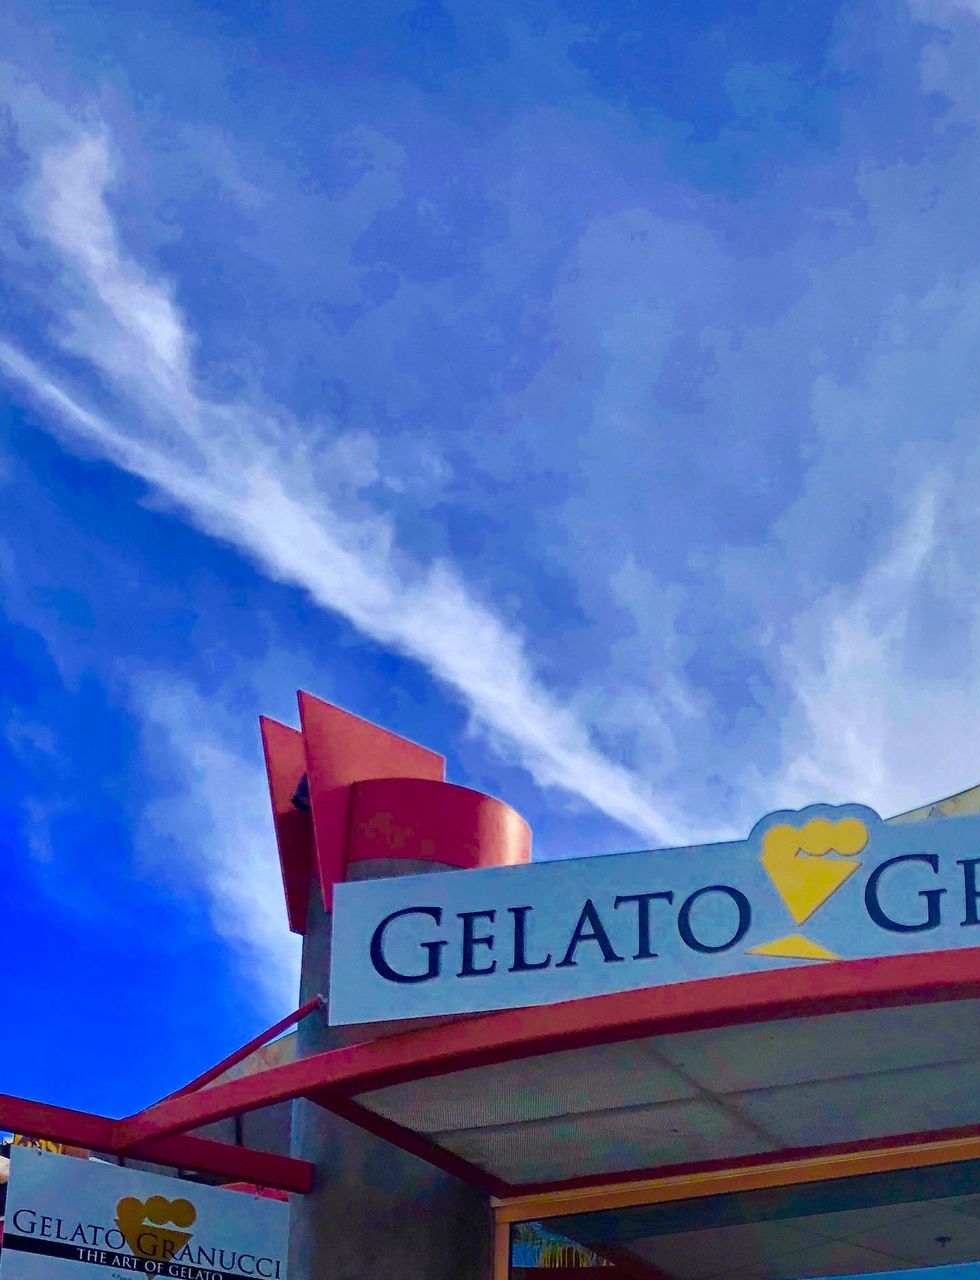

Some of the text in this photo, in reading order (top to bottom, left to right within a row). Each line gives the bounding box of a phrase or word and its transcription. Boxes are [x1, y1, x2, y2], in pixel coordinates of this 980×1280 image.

[370, 884, 752, 984] GELATO
[12, 1209, 281, 1280] GELATO GRANUCCI
[76, 1248, 107, 1264] THE
[111, 1254, 140, 1270] ART
[144, 1260, 164, 1274] OF
